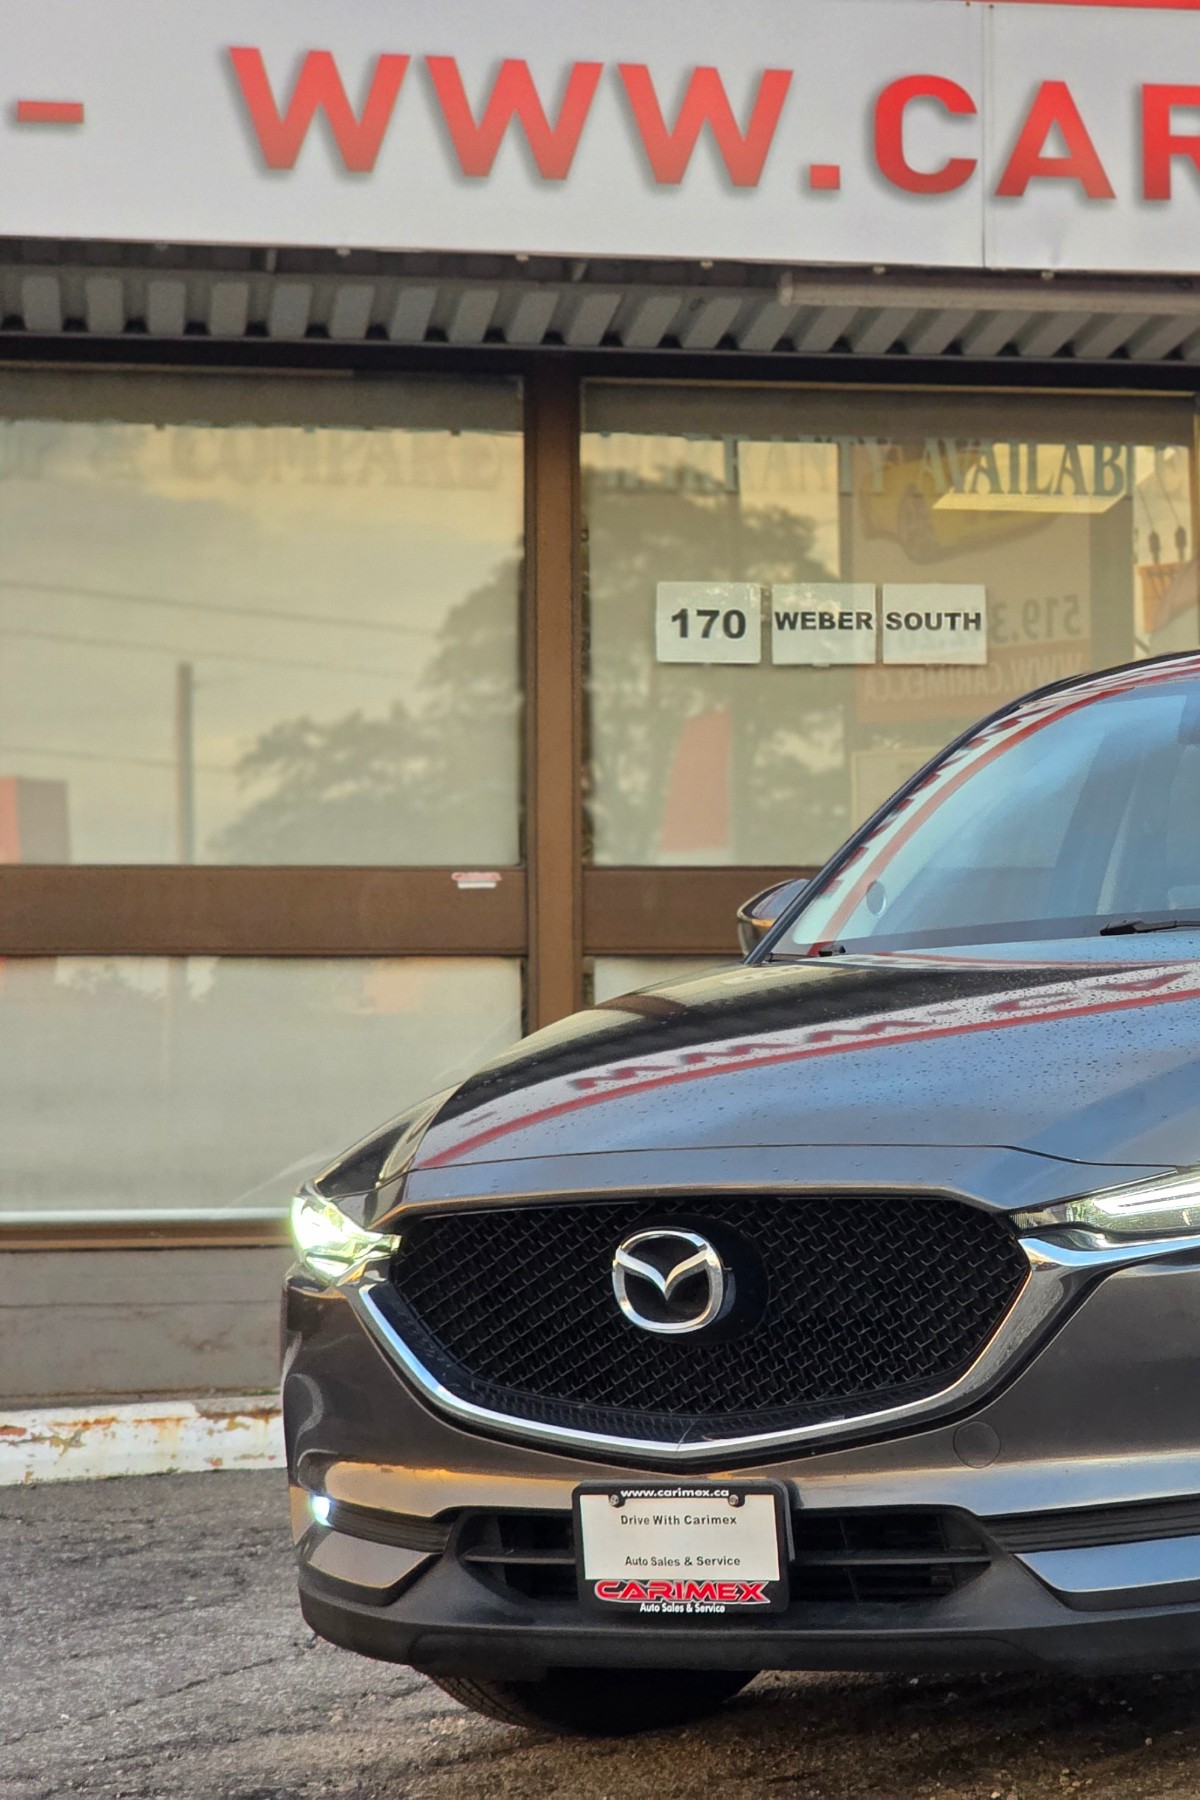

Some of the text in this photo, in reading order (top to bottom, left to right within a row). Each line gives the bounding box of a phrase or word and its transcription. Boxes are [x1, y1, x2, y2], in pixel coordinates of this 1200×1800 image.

[670, 608, 982, 639] 170 WEBER SOUTH
[620, 1487, 730, 1498] www.carimex.ca
[620, 1514, 737, 1525] Drive With Carimex
[625, 1556, 741, 1566] Auto Sales & Service
[594, 1580, 771, 1604] CARIMEX
[639, 1602, 726, 1613] Auto Sales & Service
